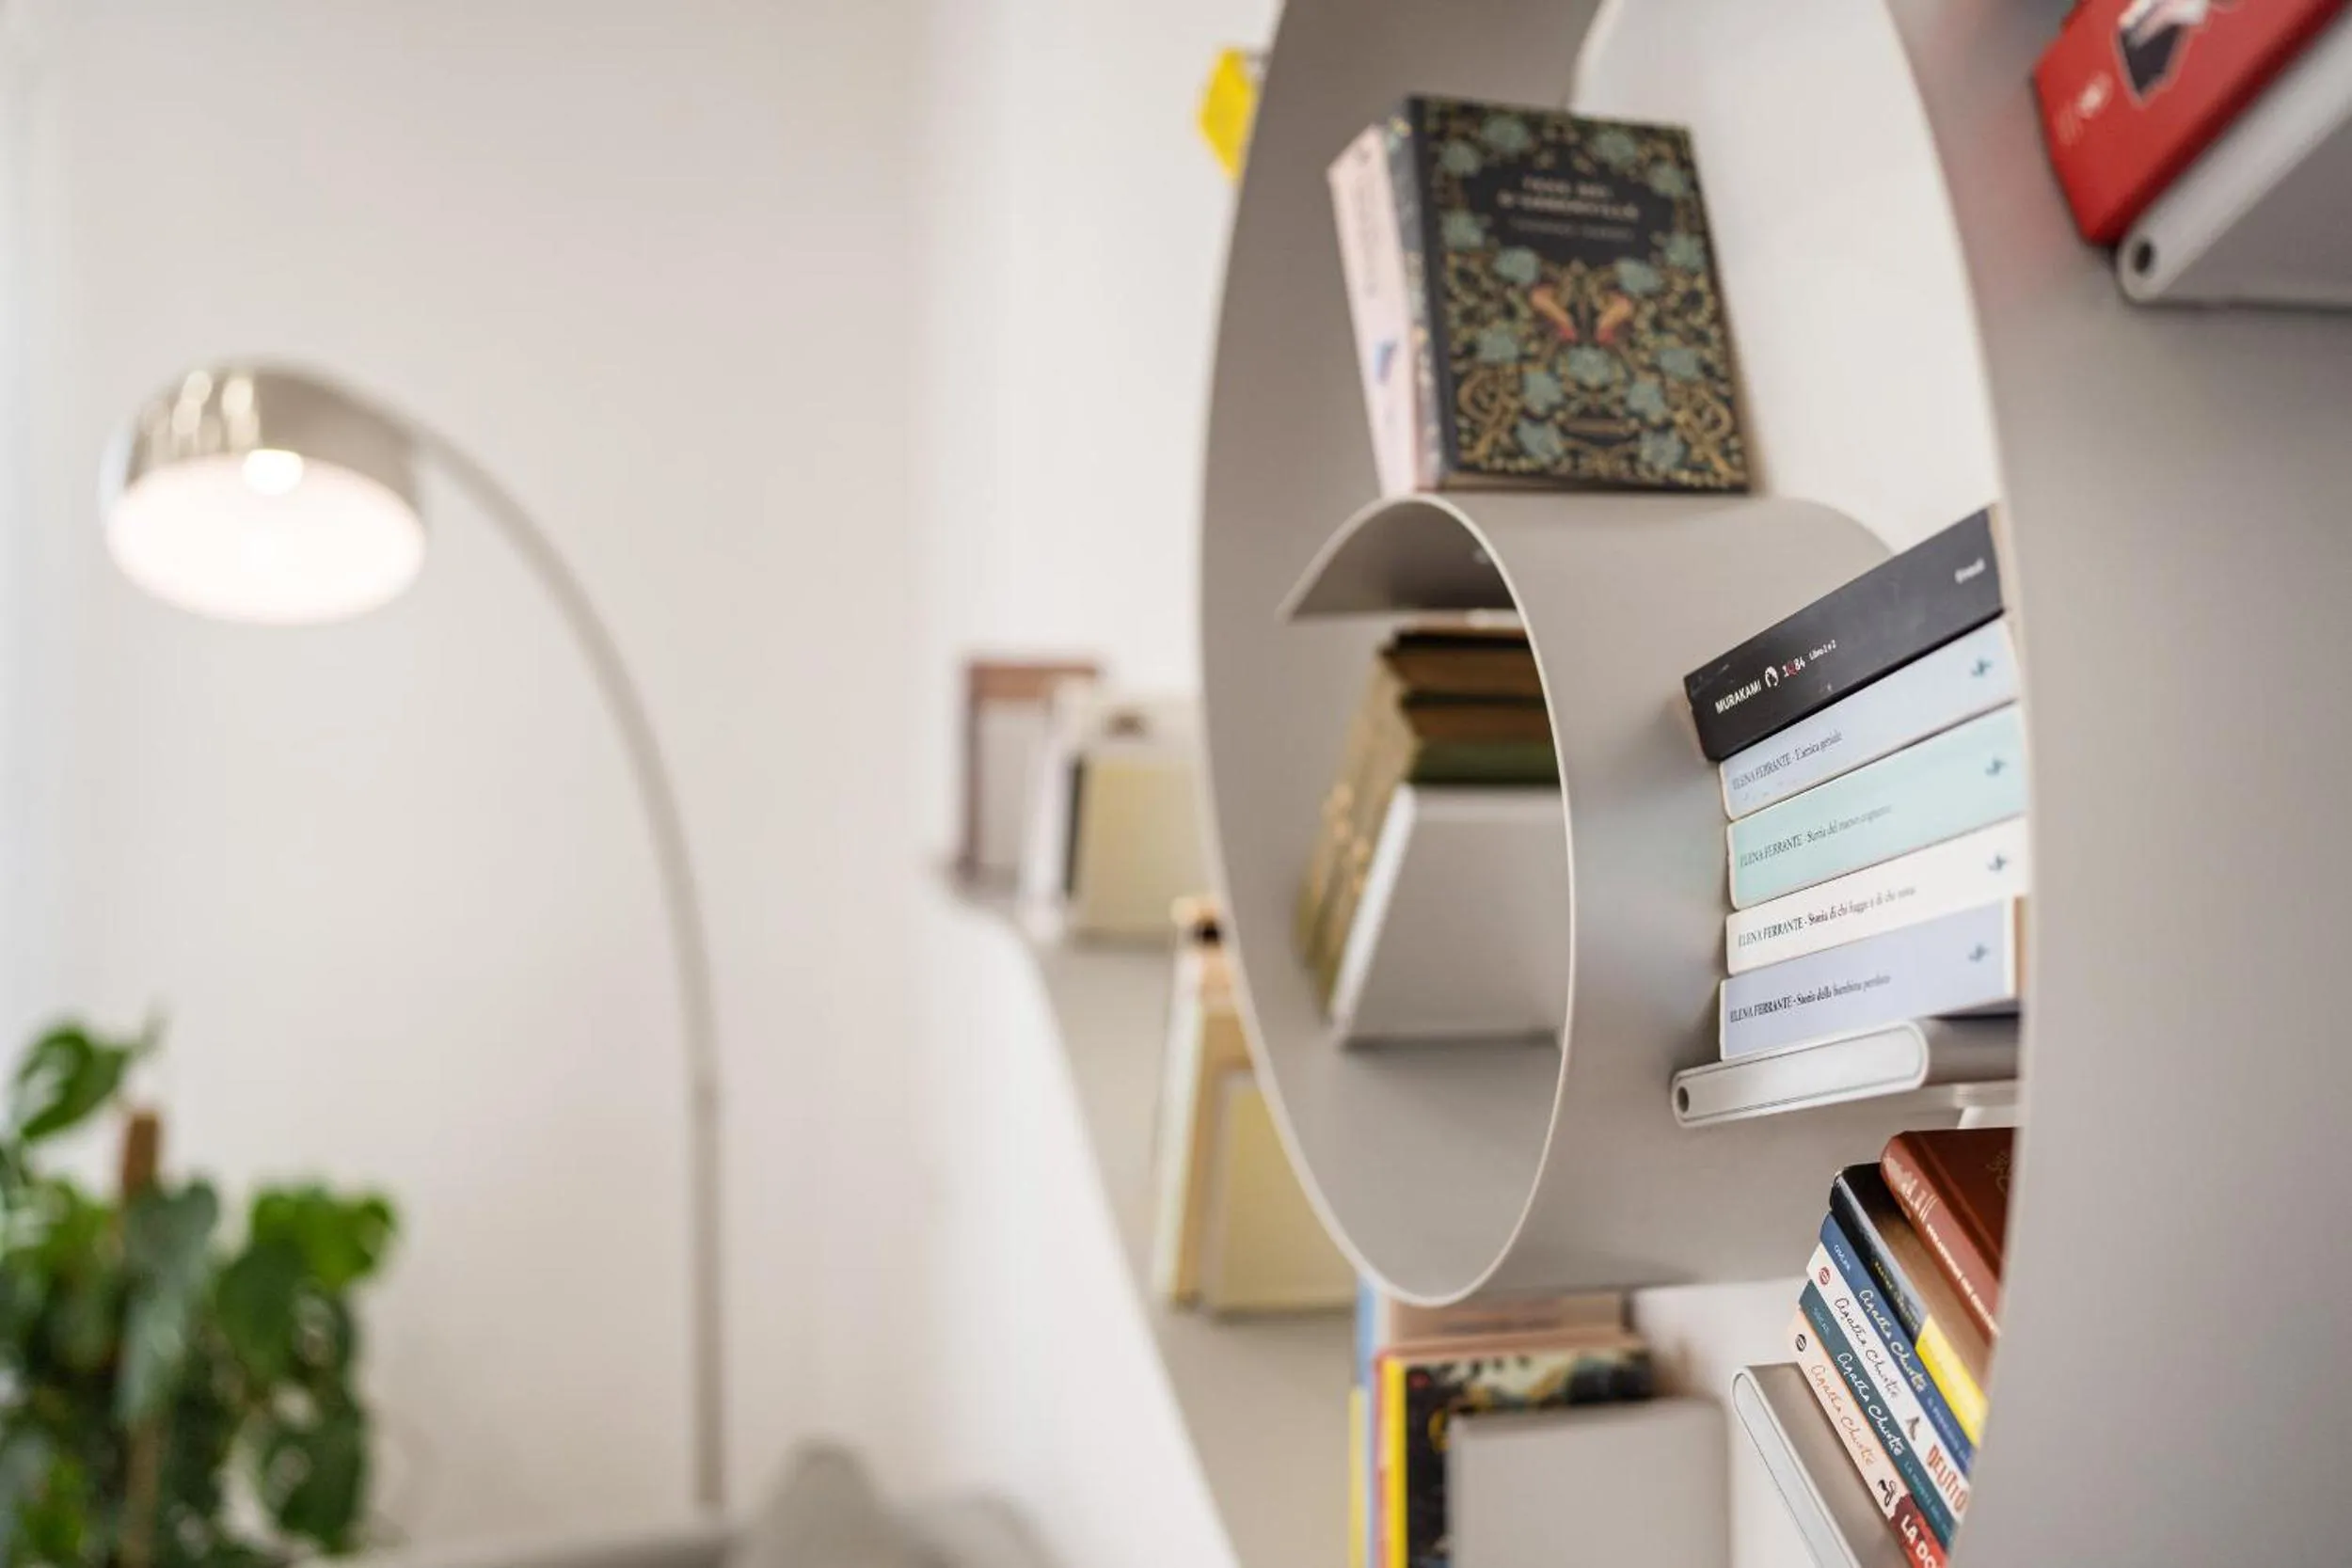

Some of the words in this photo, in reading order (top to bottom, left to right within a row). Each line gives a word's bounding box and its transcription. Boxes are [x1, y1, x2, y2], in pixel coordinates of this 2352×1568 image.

[1714, 679, 1762, 715] MURAKAMI
[1782, 657, 1805, 678] 1Q84
[1732, 767, 1755, 791] ELENA
[1754, 752, 1793, 780] FERRANTE
[1740, 849, 1764, 868] ELENA
[1764, 833, 1803, 859] FERRANTE
[1806, 826, 1826, 844] Storia
[1827, 818, 1838, 835] del
[1739, 927, 1763, 947] ELENA
[1762, 916, 1804, 941] FERRANTE
[1808, 910, 1828, 927] Storia
[1829, 905, 1837, 920] di
[1837, 901, 1848, 918] chi
[1730, 1005, 1754, 1022] ELENA
[1754, 994, 1793, 1017] FERRANTE
[1796, 989, 1816, 1006] Storia
[1817, 984, 1832, 1001] della
[1835, 1296, 1867, 1346] Agatha
[1866, 1349, 1901, 1400] Christie
[1859, 1289, 1892, 1339] Agatha
[1890, 1341, 1928, 1393] Christie
[1810, 1364, 1842, 1413] Agatha
[1840, 1416, 1876, 1466] Christie
[1837, 1352, 1869, 1402] Agatha
[1867, 1404, 1905, 1457] Christie
[1927, 1444, 1968, 1513] DELITTO
[1900, 1514, 1918, 1545] LA
